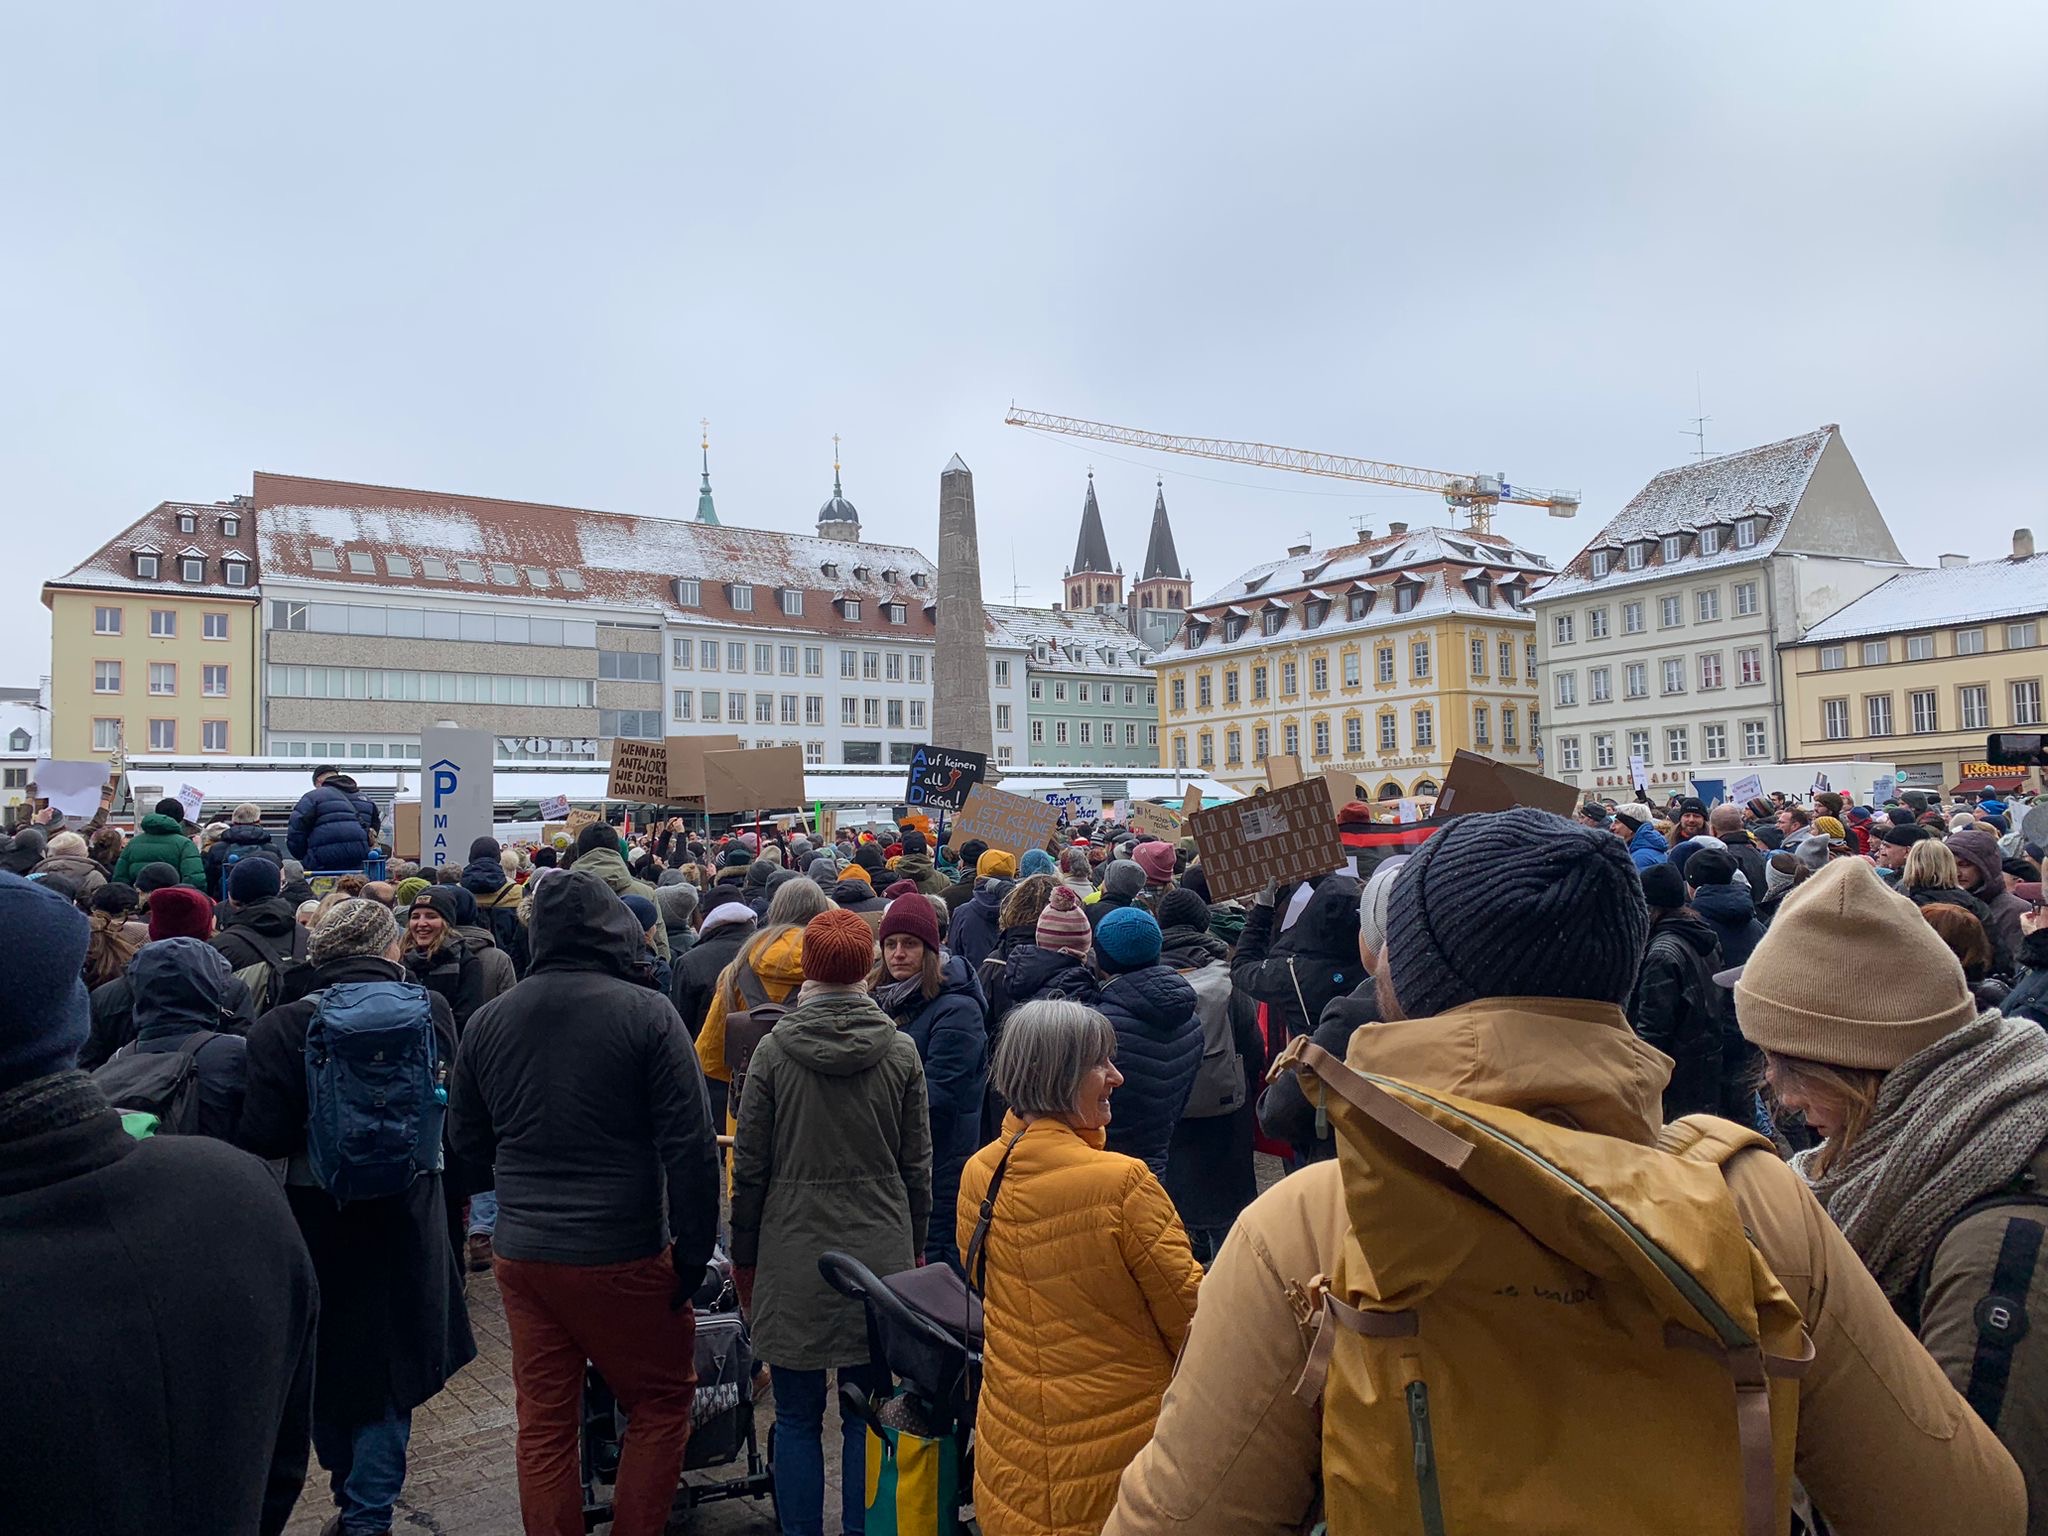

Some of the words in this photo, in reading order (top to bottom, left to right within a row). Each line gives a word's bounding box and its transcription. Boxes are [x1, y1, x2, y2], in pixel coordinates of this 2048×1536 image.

[498, 736, 598, 754] VÖLK
[621, 743, 649, 757] WENN
[650, 748, 667, 760] AFD
[912, 749, 942, 766] Auf
[945, 756, 976, 772] keinen
[616, 770, 633, 782] WIE
[912, 767, 943, 787] Fall
[434, 771, 458, 808] P
[614, 783, 646, 796] DANN
[648, 787, 663, 798] DIE
[571, 810, 597, 821] MACHT
[977, 806, 1004, 824] IST
[1007, 813, 1051, 837] KEINE
